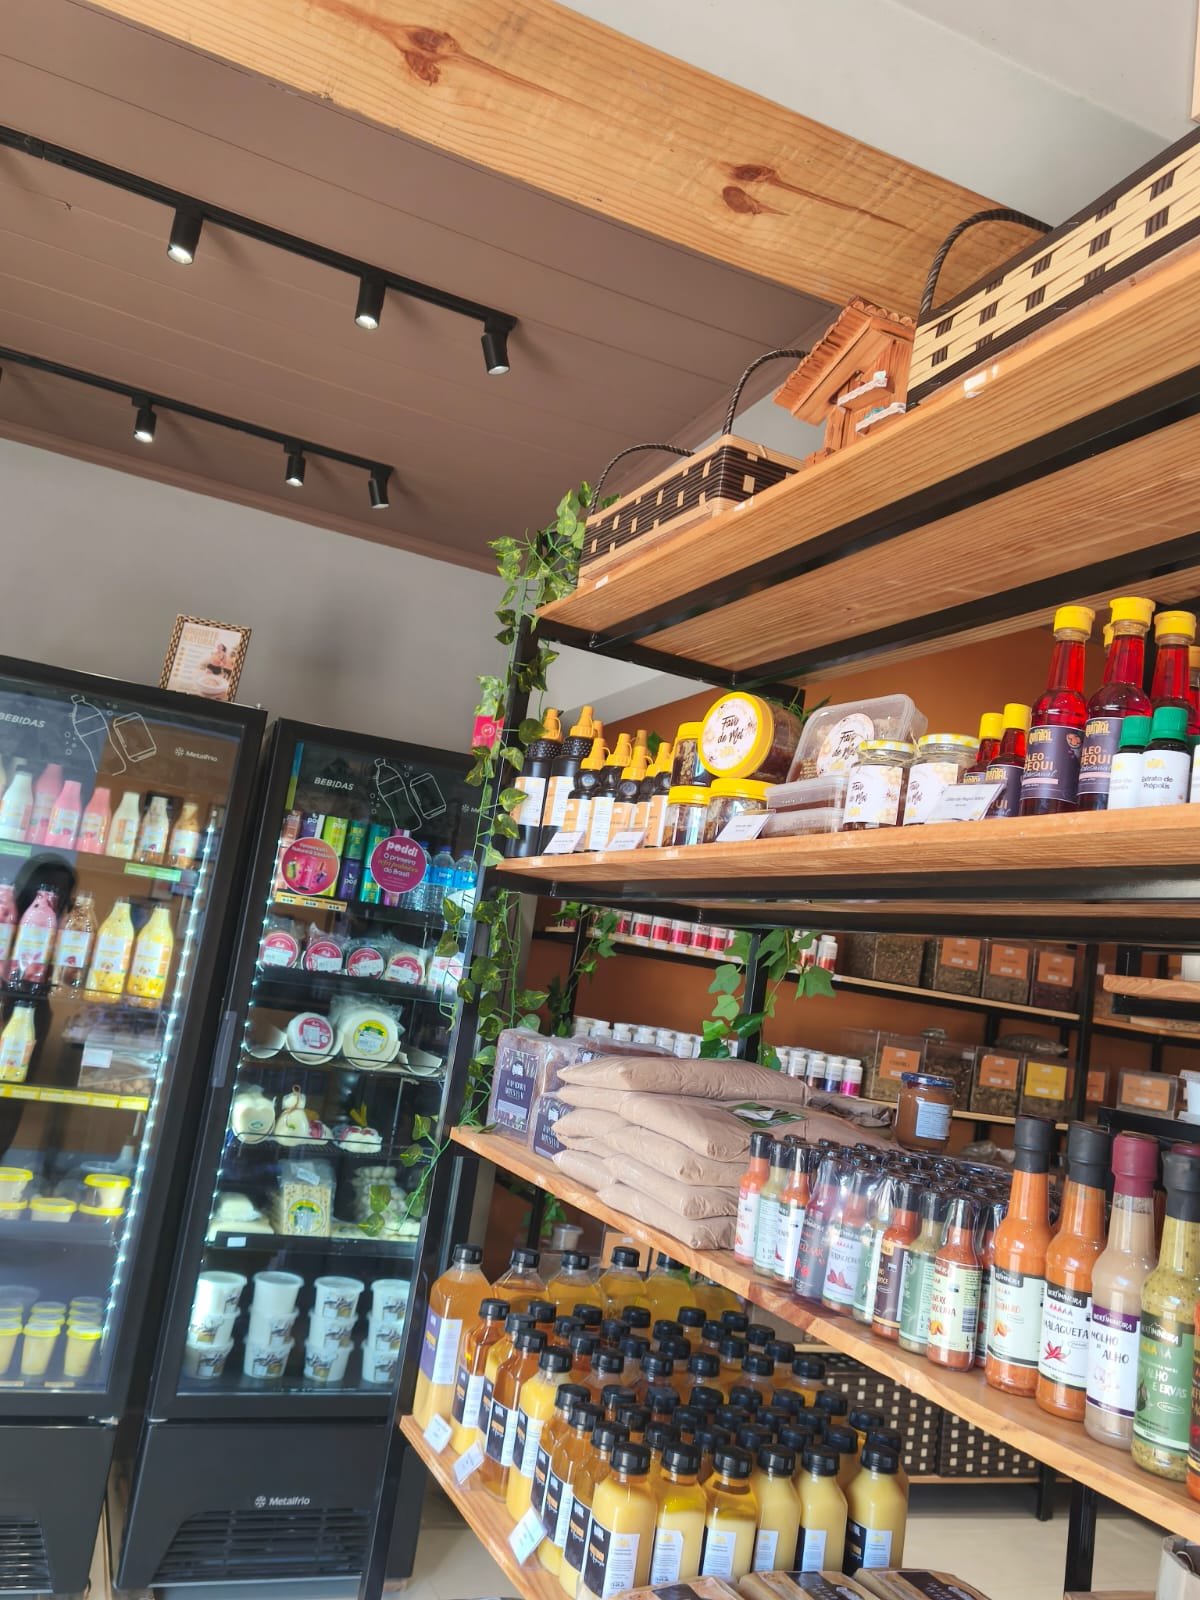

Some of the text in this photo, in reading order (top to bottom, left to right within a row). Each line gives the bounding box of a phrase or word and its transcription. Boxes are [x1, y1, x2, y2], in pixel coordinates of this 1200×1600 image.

[721, 714, 740, 732] Favo
[717, 732, 727, 744] de
[313, 776, 354, 791] BEBIDAS
[1143, 782, 1170, 790] Própolis
[1102, 1349, 1130, 1364] ALHO
[1152, 1381, 1188, 1399] E ERVAS
[269, 1496, 310, 1506] Metalfrio
